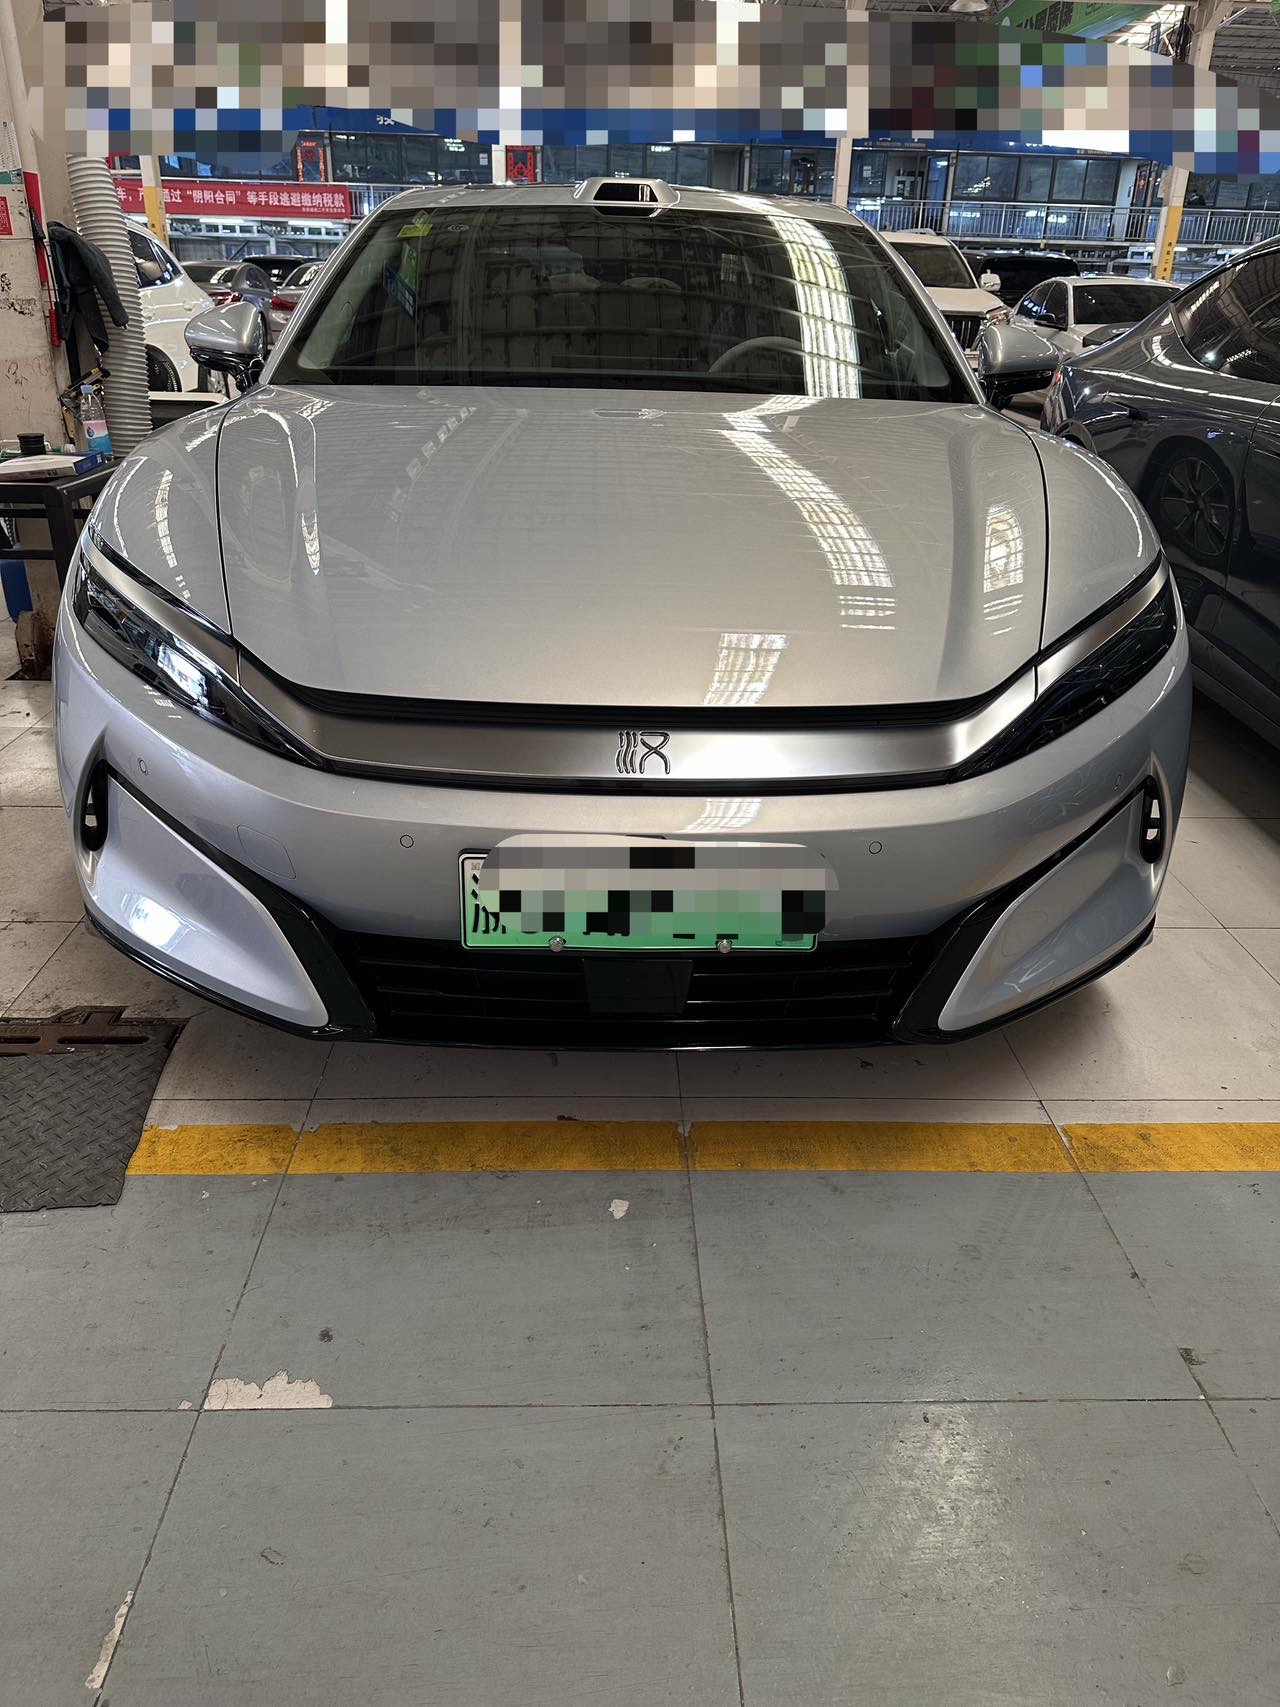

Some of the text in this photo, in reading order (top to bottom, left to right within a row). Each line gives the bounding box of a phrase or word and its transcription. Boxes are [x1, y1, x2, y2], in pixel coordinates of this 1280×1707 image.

[116, 187, 345, 208] 车，通过“阴阳合同”等手段逃避缴纳税款
